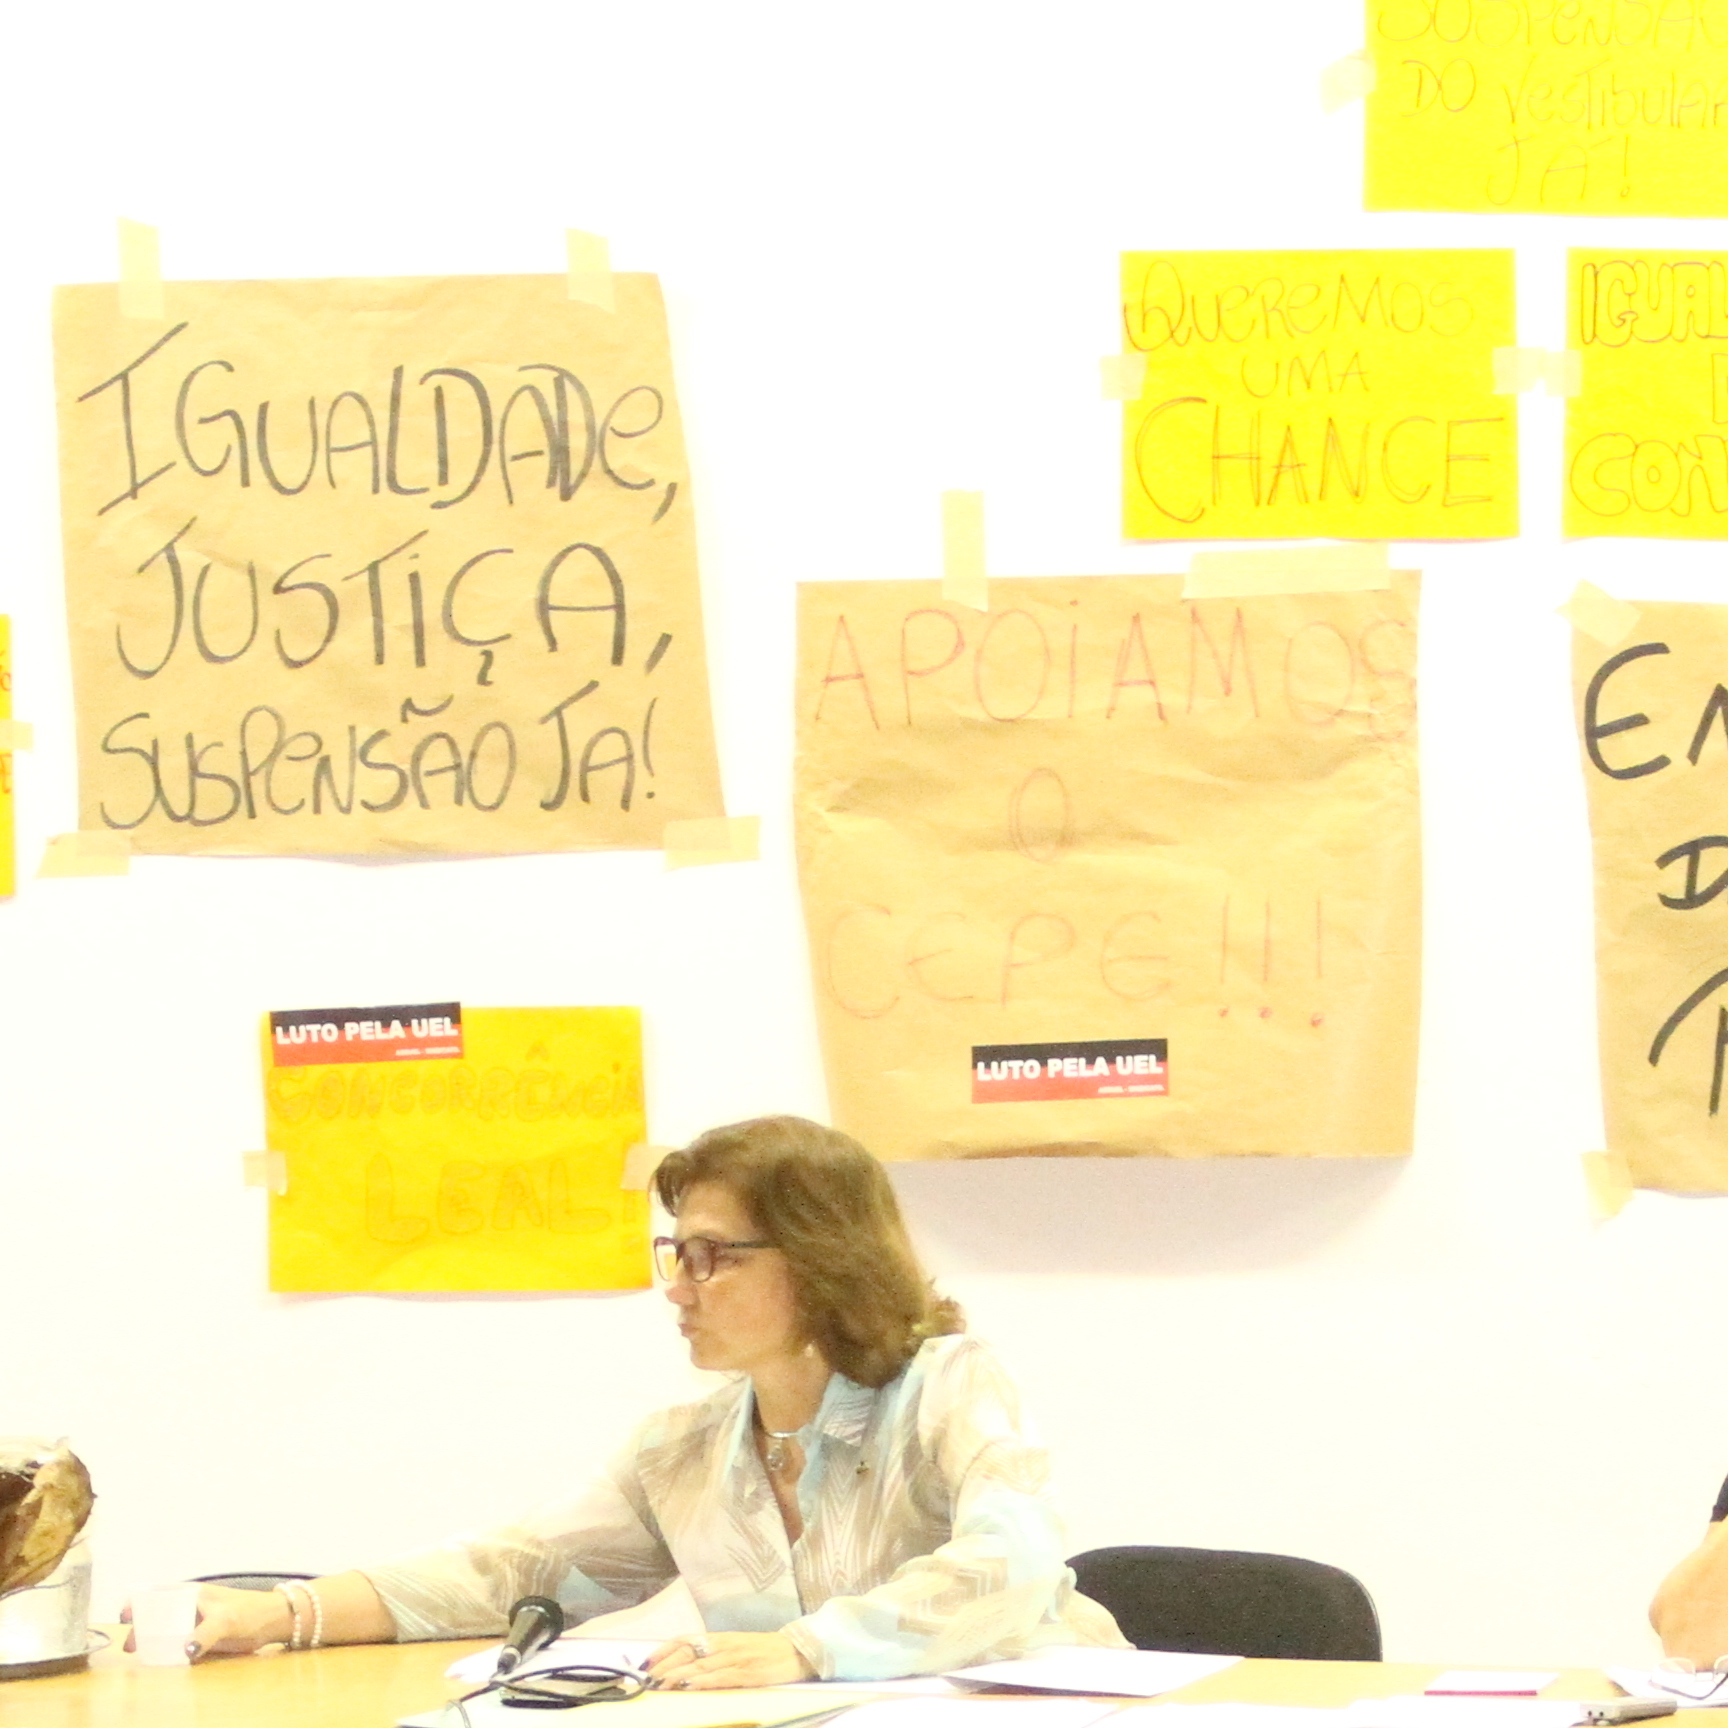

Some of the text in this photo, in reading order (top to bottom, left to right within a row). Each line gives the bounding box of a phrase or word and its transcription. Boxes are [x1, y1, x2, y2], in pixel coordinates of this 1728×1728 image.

[1401, 58, 1477, 118] DO
[1241, 350, 1369, 398] UMA
[1135, 397, 1504, 523] CHANCE
[116, 517, 674, 685] JUSTIÇA,
[815, 599, 1418, 742] APOIAMOS
[275, 1016, 459, 1044] LUTO PELA UEL
[977, 1054, 1164, 1081] LUTO PELA UEL
